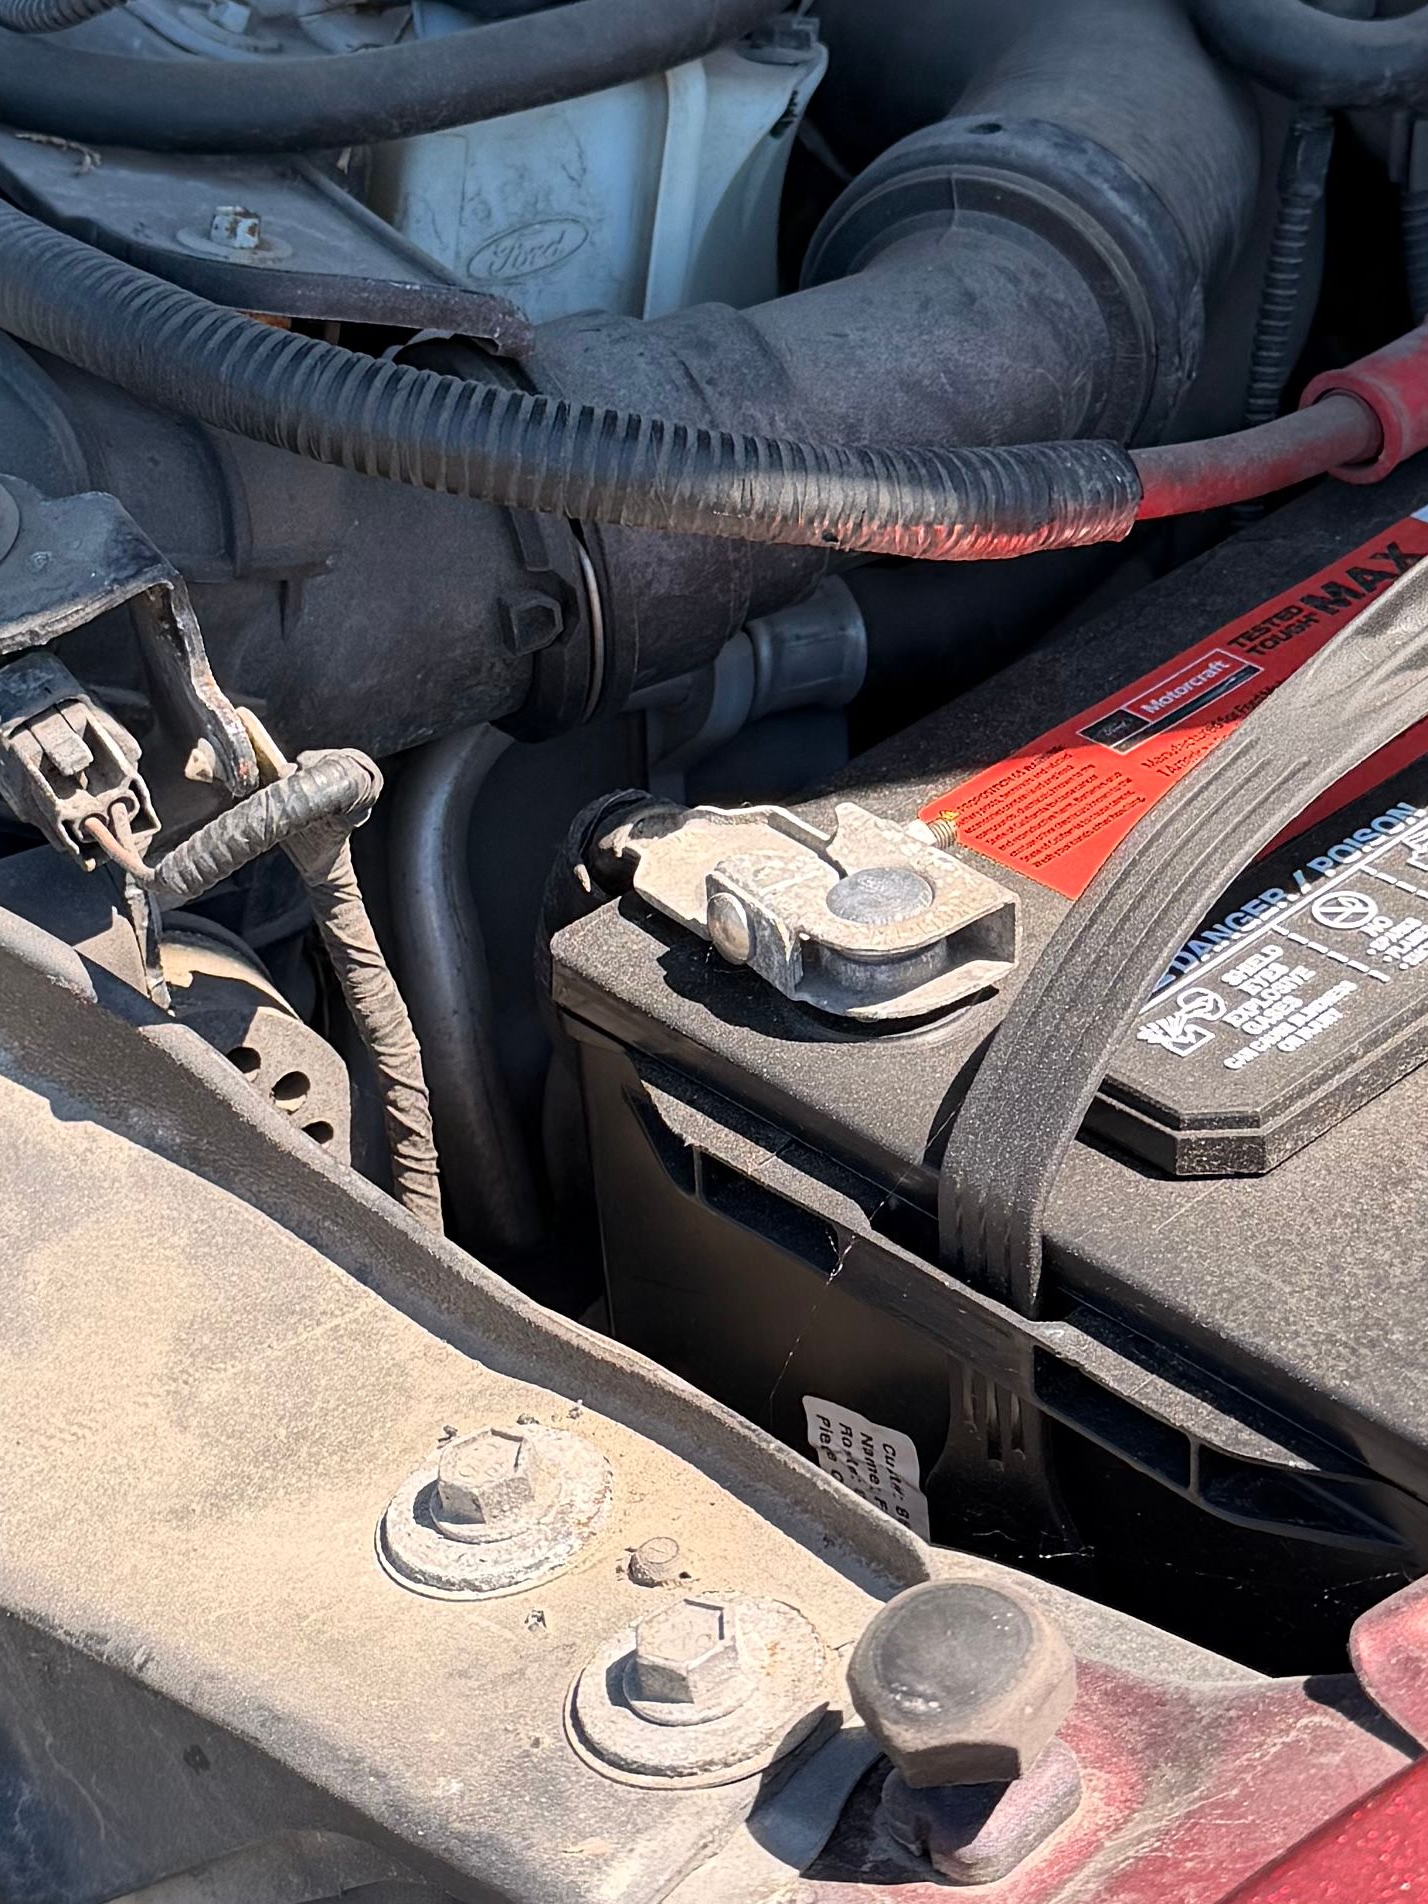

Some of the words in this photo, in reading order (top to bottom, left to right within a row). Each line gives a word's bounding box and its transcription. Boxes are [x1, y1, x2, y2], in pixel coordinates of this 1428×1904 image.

[486, 228, 568, 277] Ford
[1299, 540, 1425, 618] MAX
[1227, 604, 1304, 650] TESTED
[1140, 658, 1232, 715] Motorcraft
[1171, 887, 1299, 975] DANGER
[1306, 802, 1428, 878] POISON
[1221, 944, 1284, 987] SHIELD
